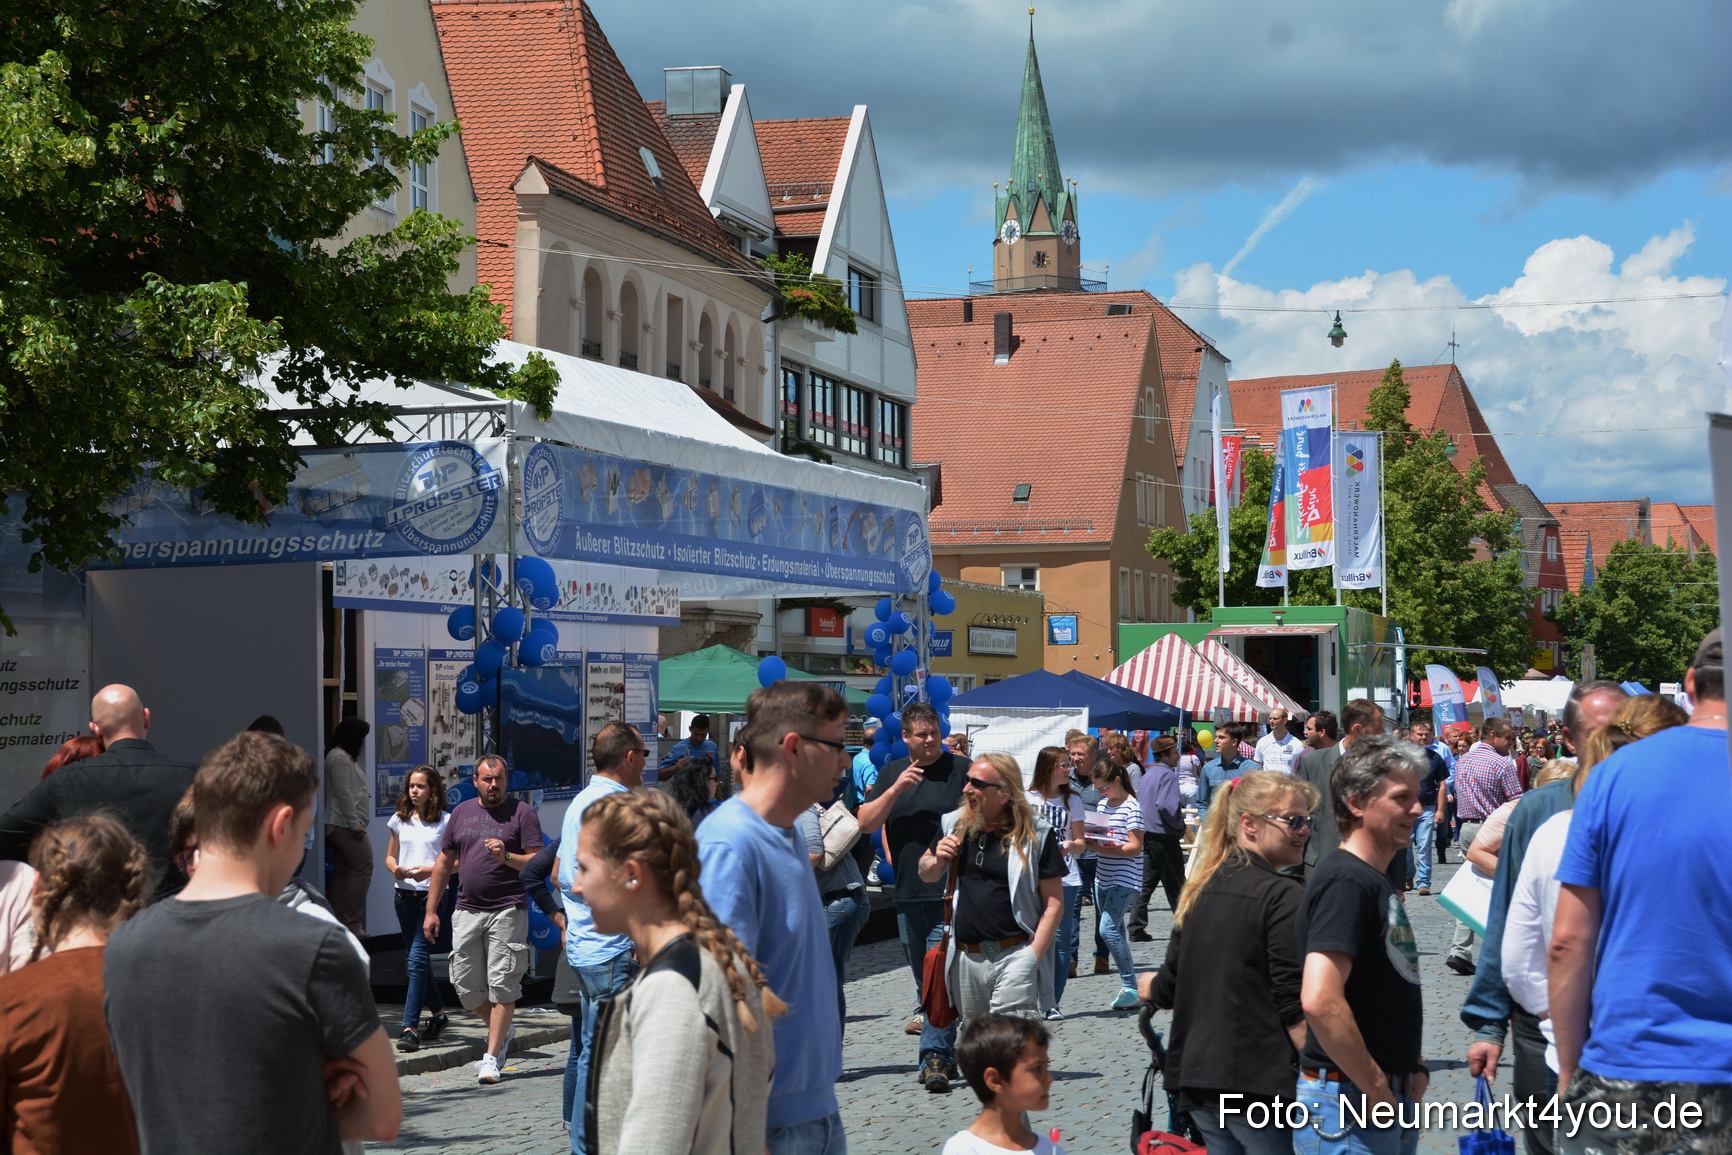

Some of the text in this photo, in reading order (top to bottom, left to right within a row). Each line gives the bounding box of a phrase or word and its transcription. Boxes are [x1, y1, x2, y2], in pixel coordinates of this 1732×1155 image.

[396, 444, 484, 500] Blitzschutztechnik
[1225, 442, 1236, 480] RUPPERT
[388, 471, 502, 527] J.PRÖPSTER
[428, 505, 459, 526] Sicherheit
[115, 529, 387, 563] berspannungsschutz
[401, 495, 495, 554] Überspannungsschutz
[431, 517, 449, 532] immer
[575, 525, 896, 587] Äußerer Blitzschutz Isolierter Blitzschutz Erdungsmaterial Überspannungsschutz
